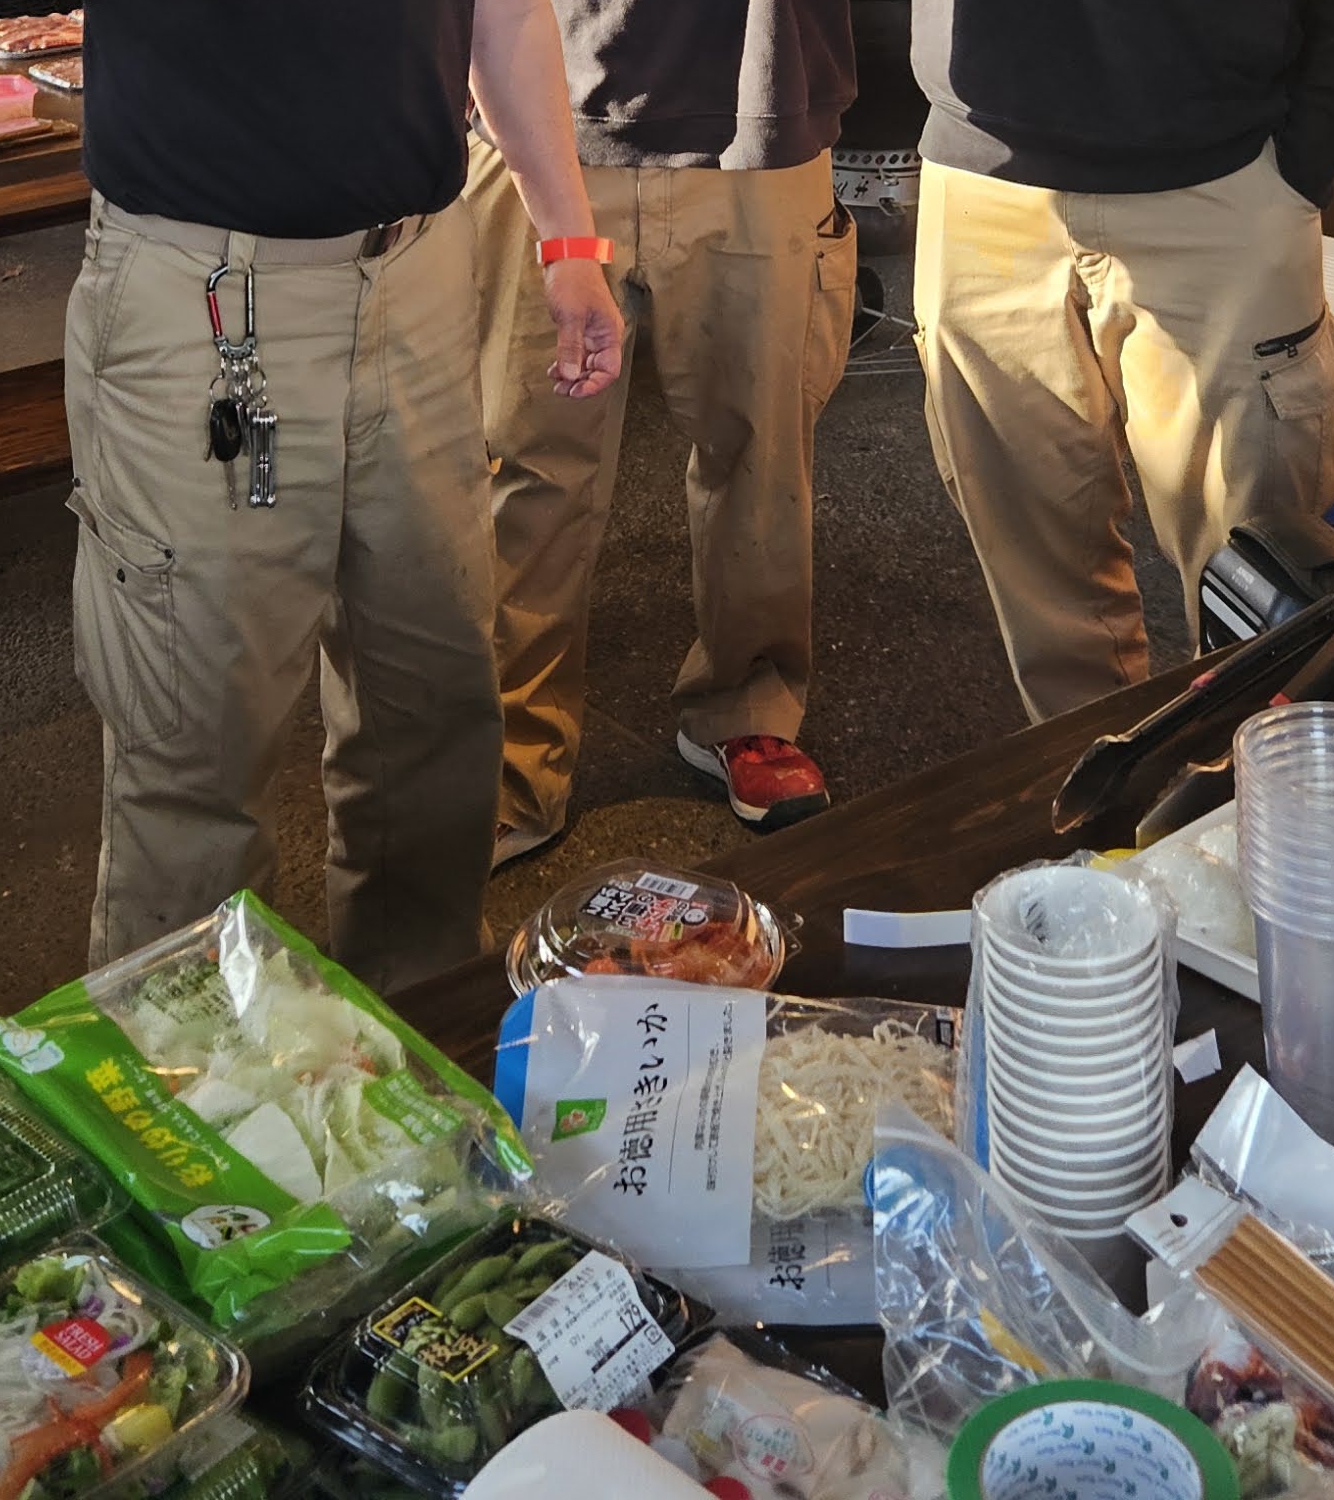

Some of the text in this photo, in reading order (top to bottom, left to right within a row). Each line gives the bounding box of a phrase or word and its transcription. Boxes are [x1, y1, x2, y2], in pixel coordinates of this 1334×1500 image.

[612, 1002, 669, 1198] お徳用さきいか
[619, 1305, 644, 1331] 179
[54, 1330, 93, 1360] SALAD
[65, 1322, 104, 1352] FRESH
